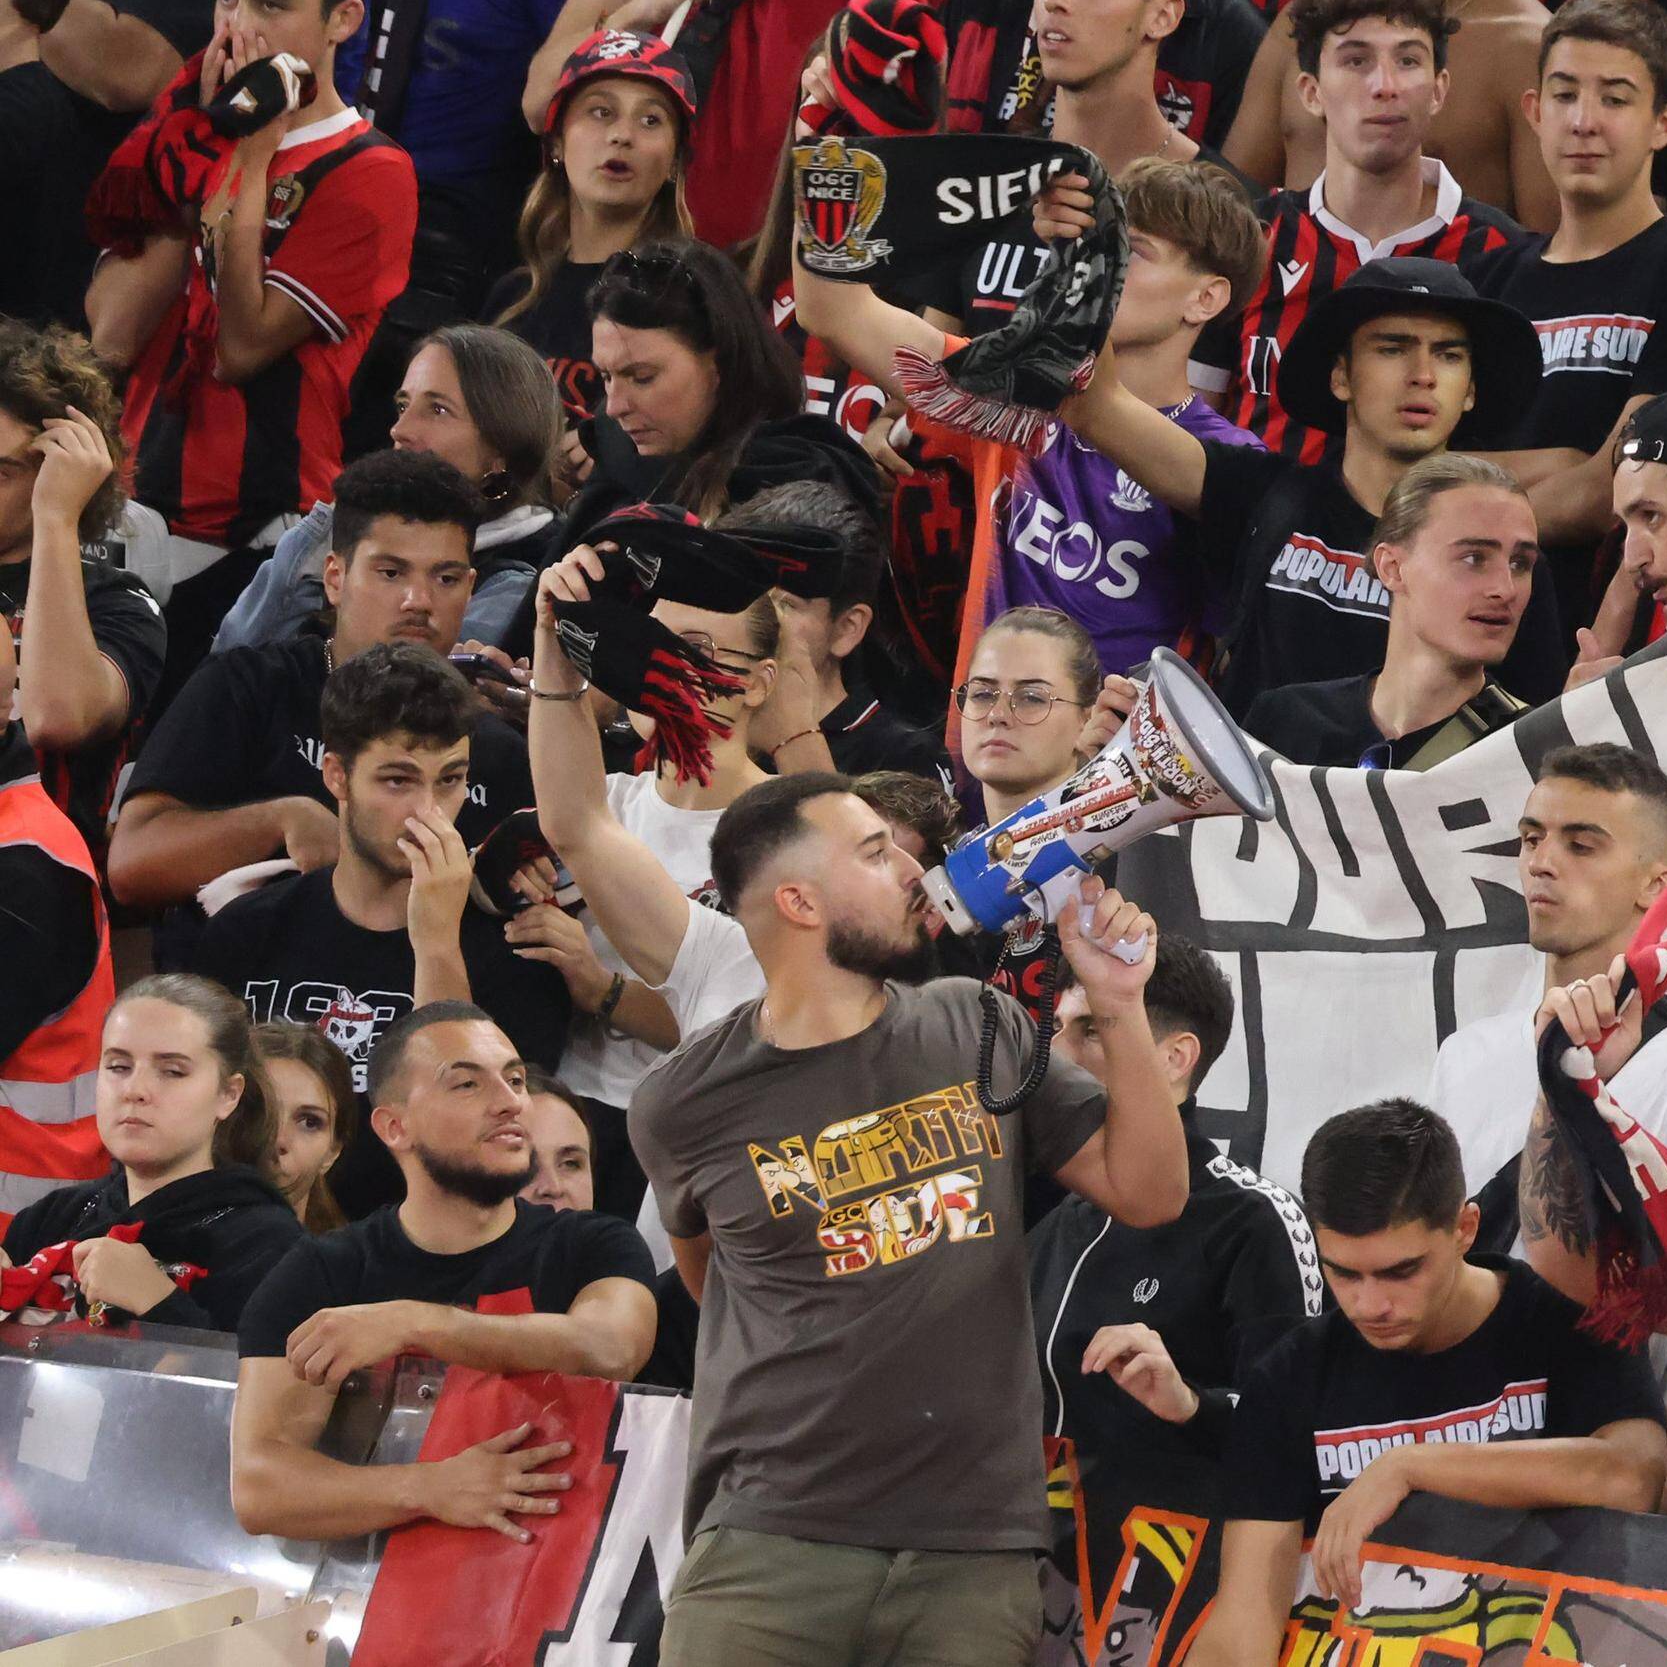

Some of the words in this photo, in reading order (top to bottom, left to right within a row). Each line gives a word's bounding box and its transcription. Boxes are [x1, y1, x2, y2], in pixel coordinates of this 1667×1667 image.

[807, 187, 855, 201] NICE
[808, 172, 854, 186] OGC
[747, 1083, 1002, 1218] NORTH
[817, 1164, 994, 1279] SIDE
